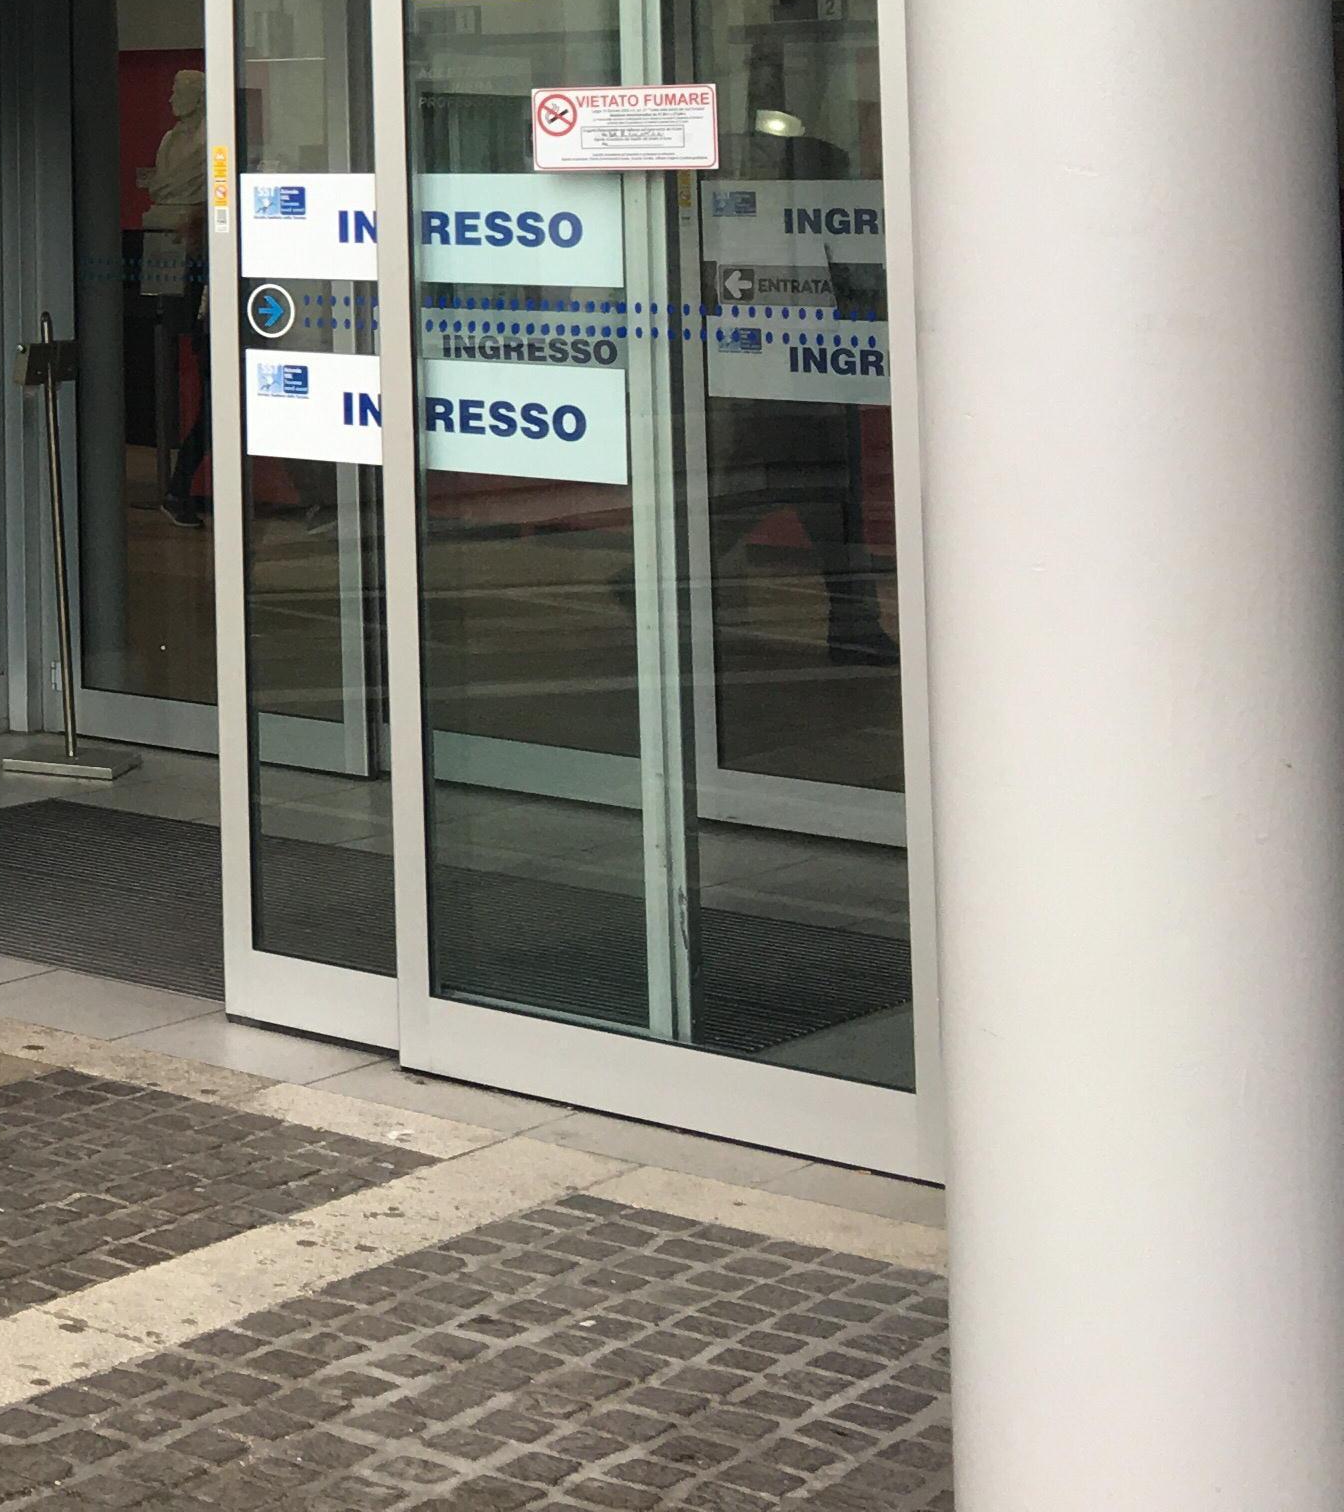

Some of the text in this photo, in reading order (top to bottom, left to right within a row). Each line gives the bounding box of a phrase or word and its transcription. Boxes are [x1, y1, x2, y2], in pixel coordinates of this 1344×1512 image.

[576, 91, 711, 109] VIETATO FUMARE
[338, 209, 584, 248] INRESSO
[783, 207, 886, 236] INGR
[757, 278, 833, 295] ENTRATA
[442, 334, 618, 365] INGRESSO
[789, 345, 891, 377] INGR
[343, 391, 587, 442] INRESSO
